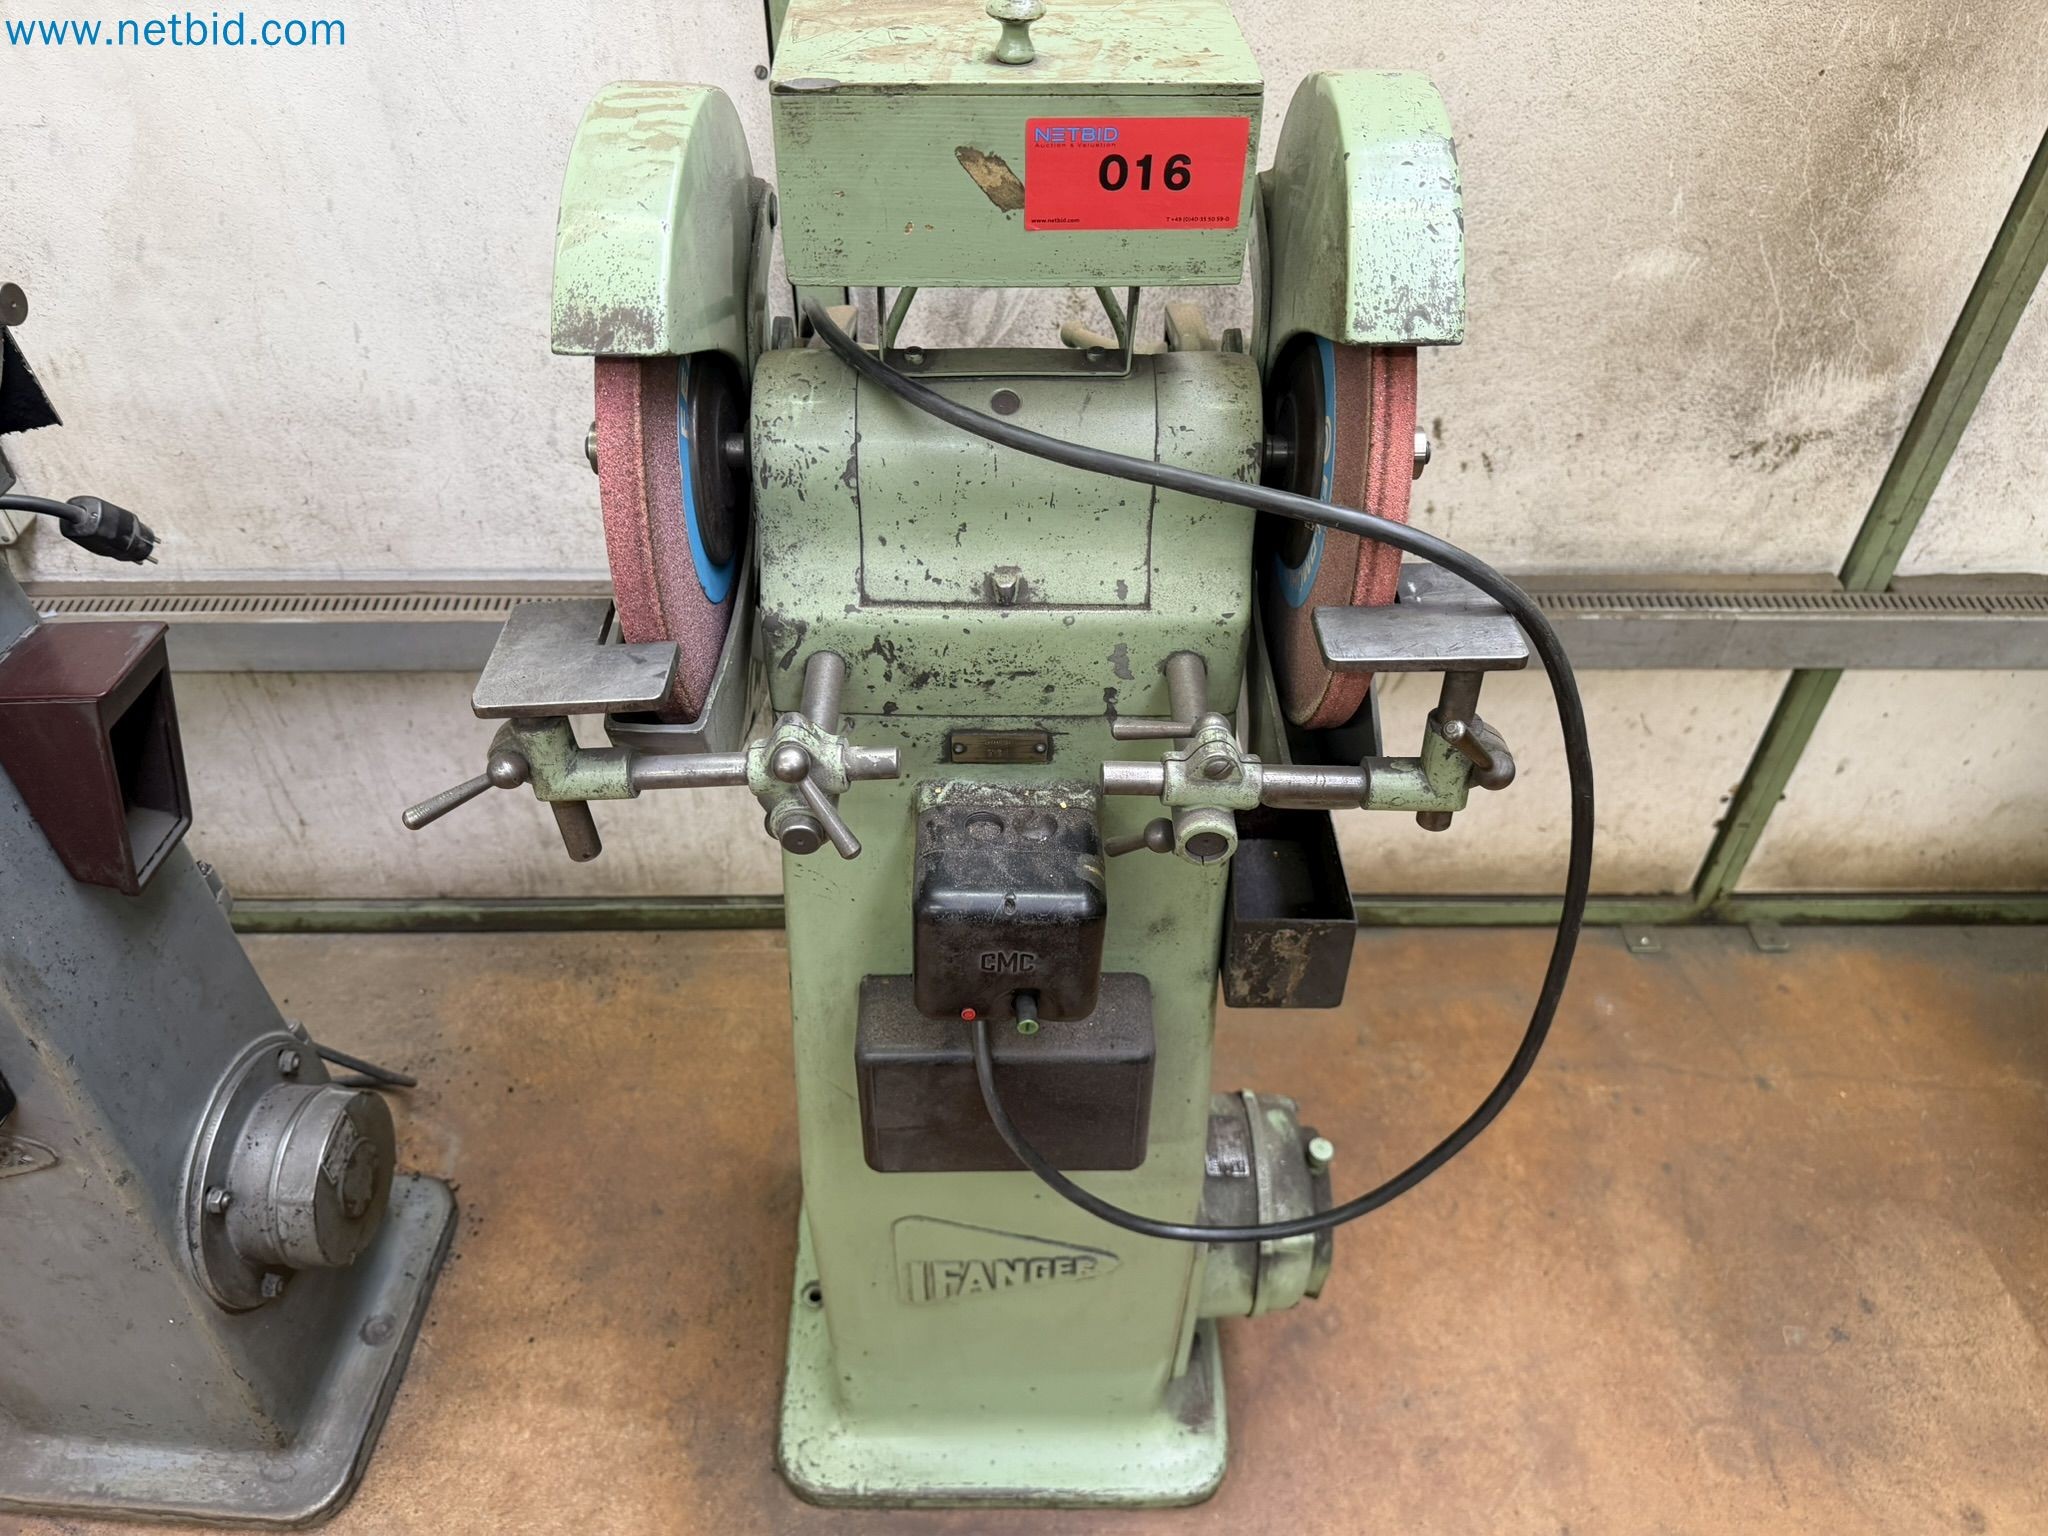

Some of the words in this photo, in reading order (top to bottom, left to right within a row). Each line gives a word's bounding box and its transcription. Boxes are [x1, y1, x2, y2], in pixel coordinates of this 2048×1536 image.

[1035, 127, 1119, 142] NETBID
[1098, 153, 1192, 191] 016
[981, 951, 1034, 973] CMC
